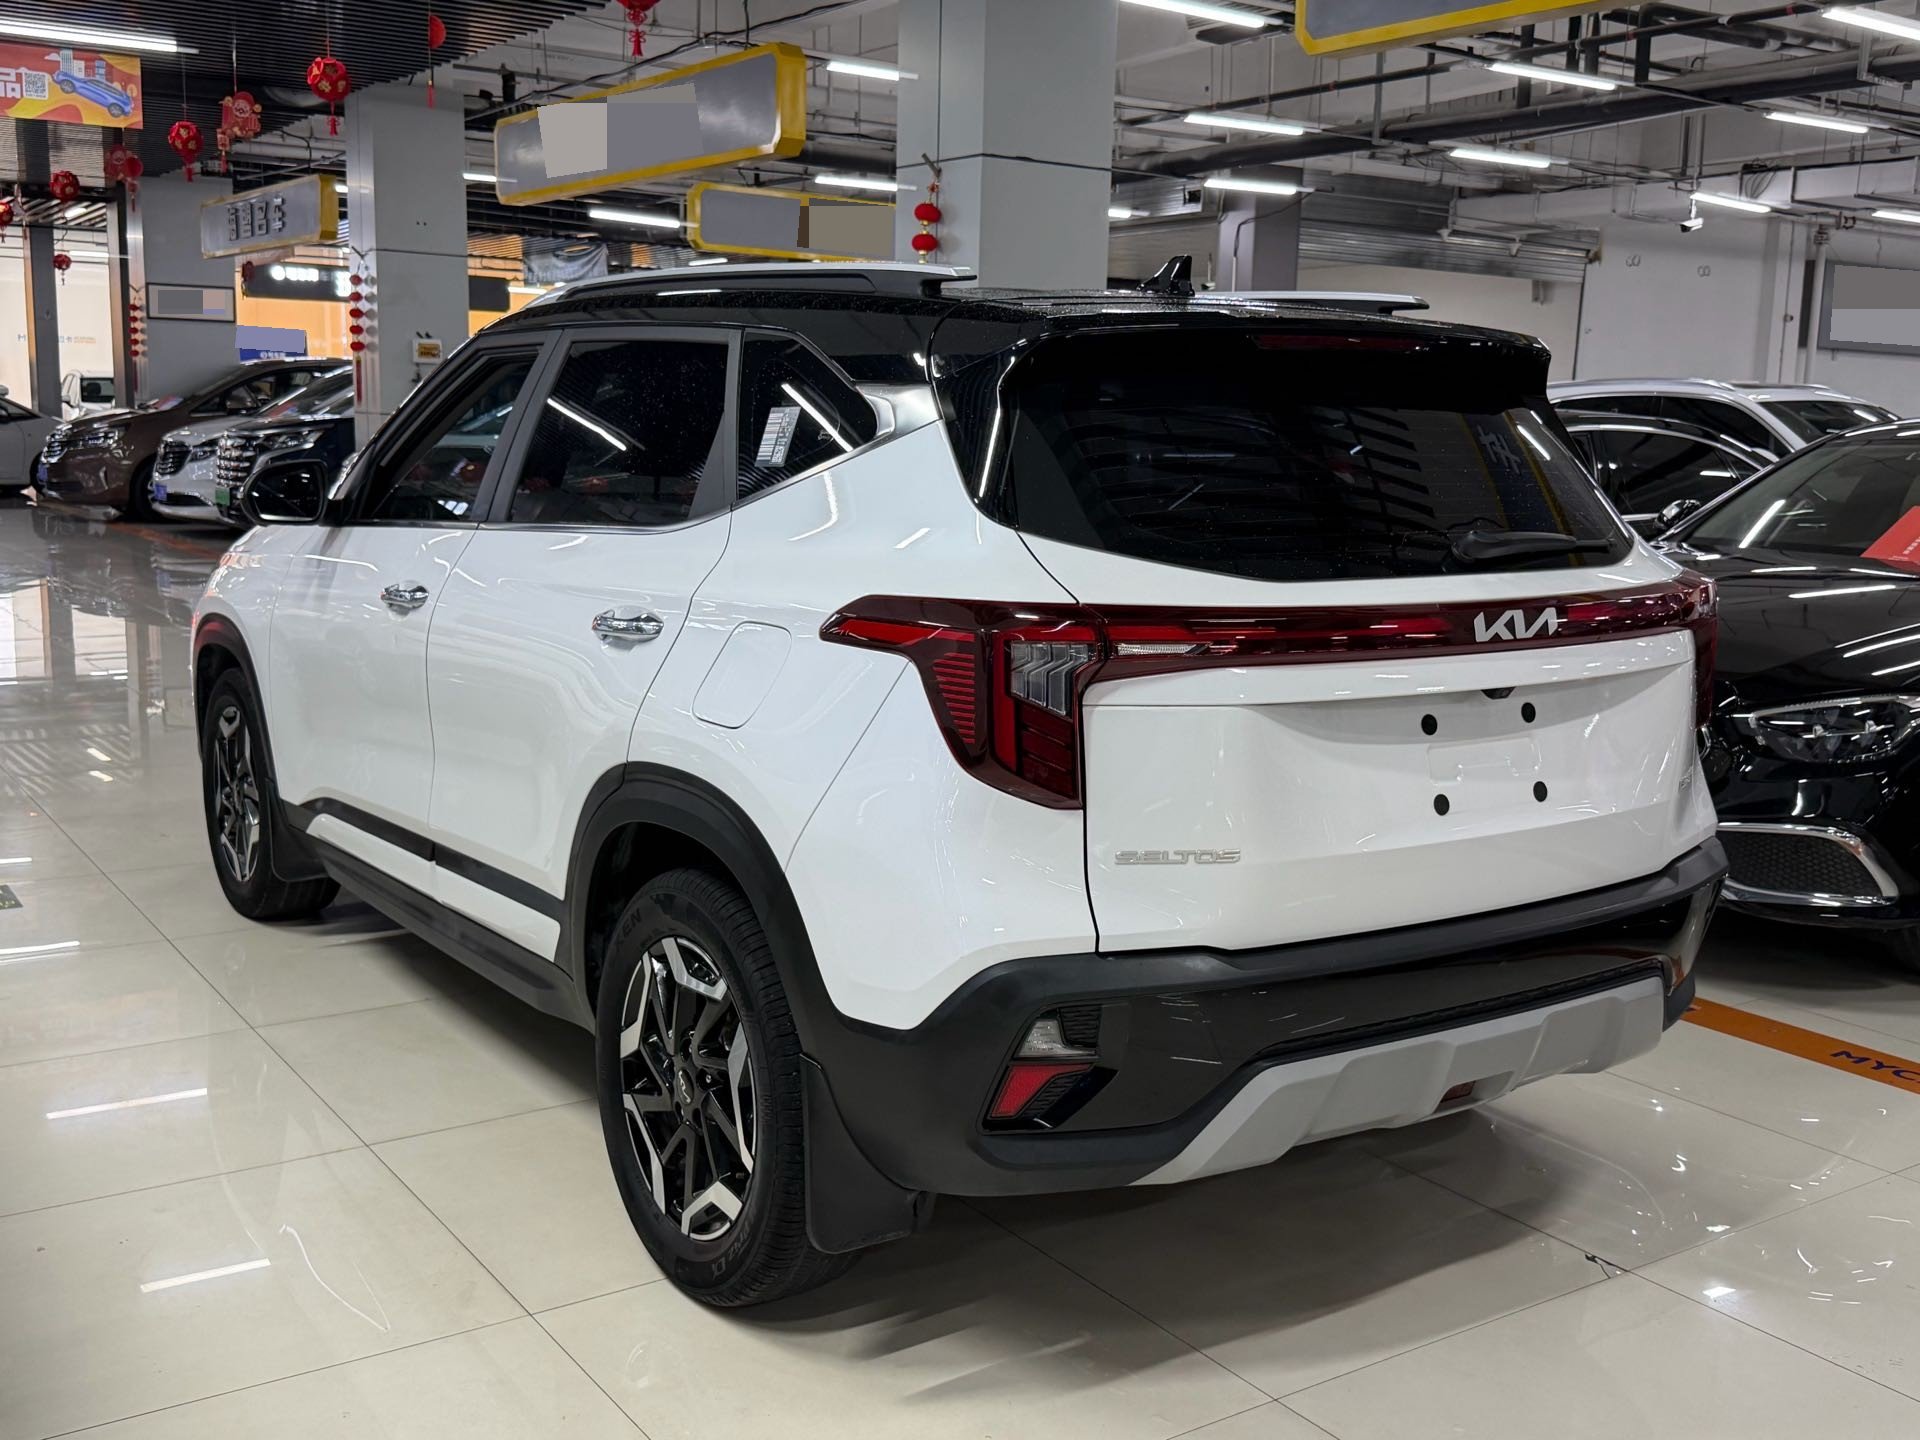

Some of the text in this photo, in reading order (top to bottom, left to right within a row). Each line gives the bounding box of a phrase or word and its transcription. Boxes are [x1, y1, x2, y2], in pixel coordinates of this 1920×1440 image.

[1473, 606, 1558, 643] KIA
[1114, 849, 1241, 865] SELTOS
[1829, 1050, 1920, 1083] MYC
